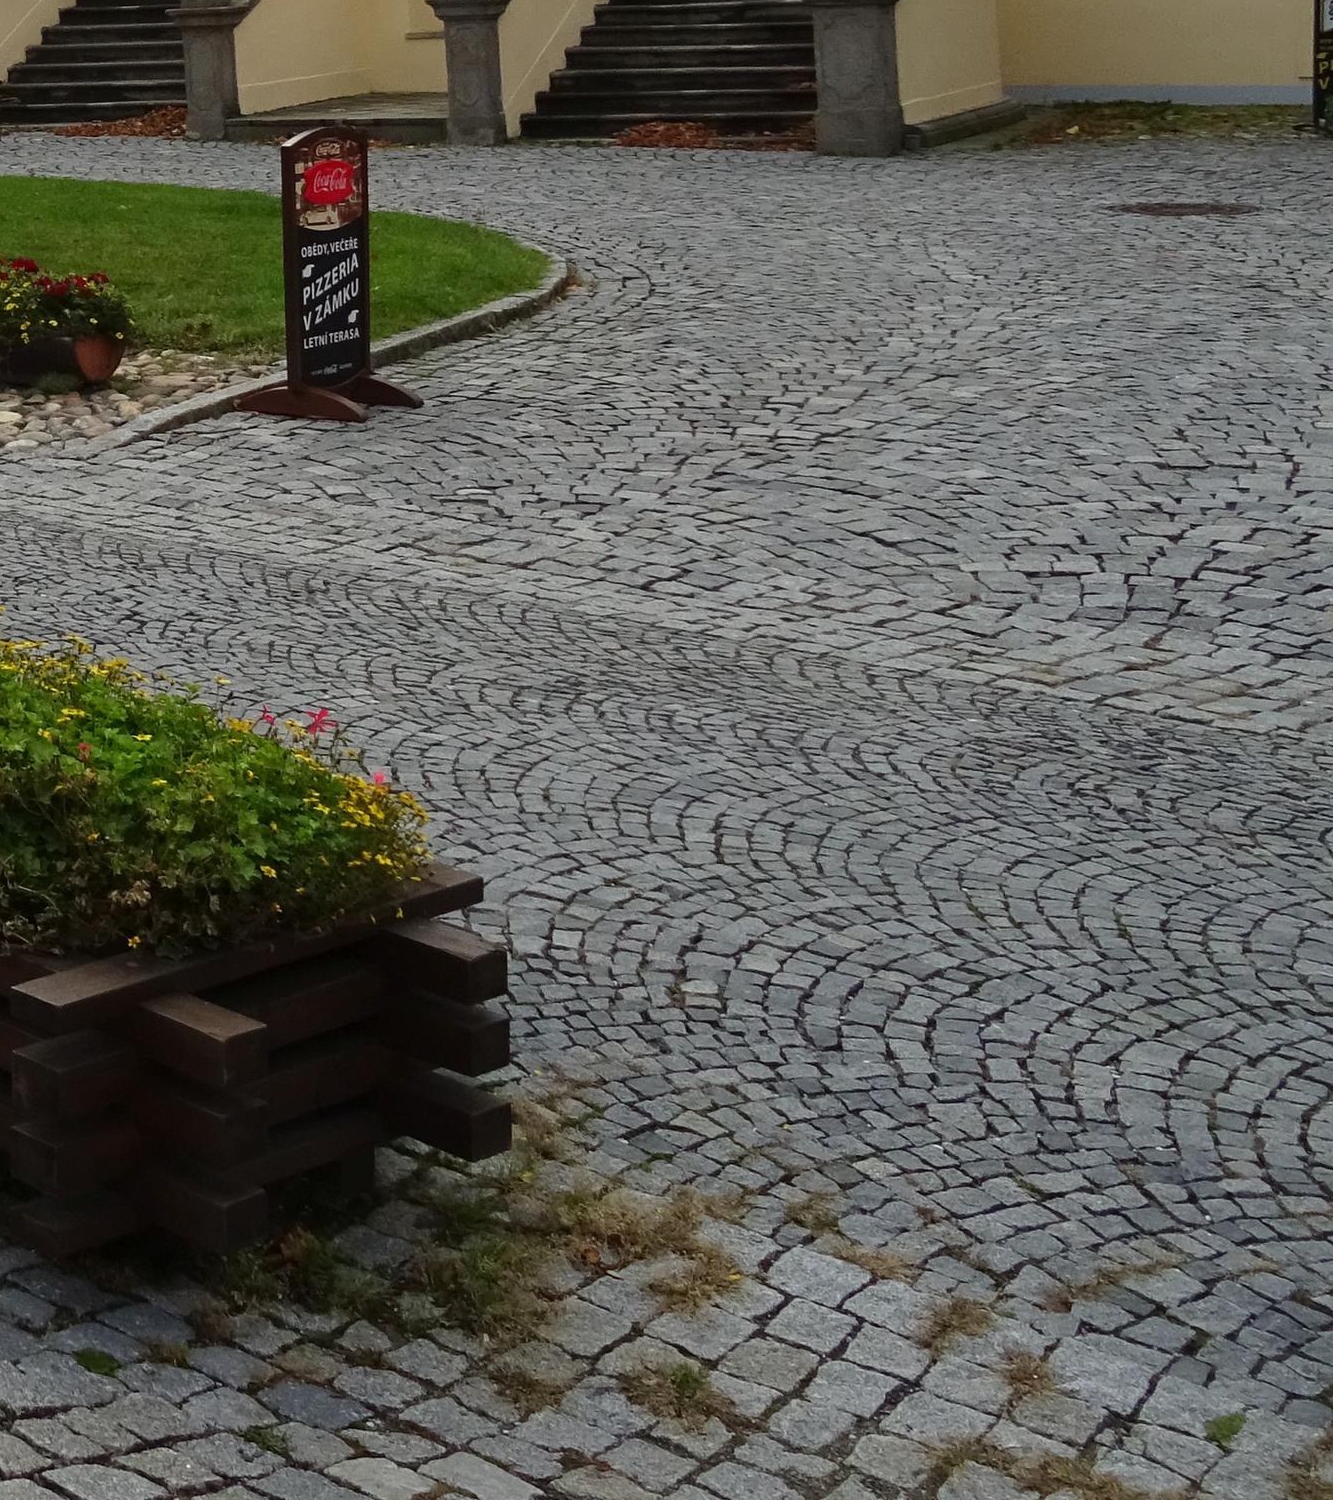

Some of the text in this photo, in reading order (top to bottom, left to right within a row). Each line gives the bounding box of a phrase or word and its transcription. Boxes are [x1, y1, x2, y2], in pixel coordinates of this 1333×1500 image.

[303, 252, 359, 305] PIZZERIA
[303, 277, 359, 331] V ZÁMKU
[303, 328, 360, 349] LETNÍ TERASA
